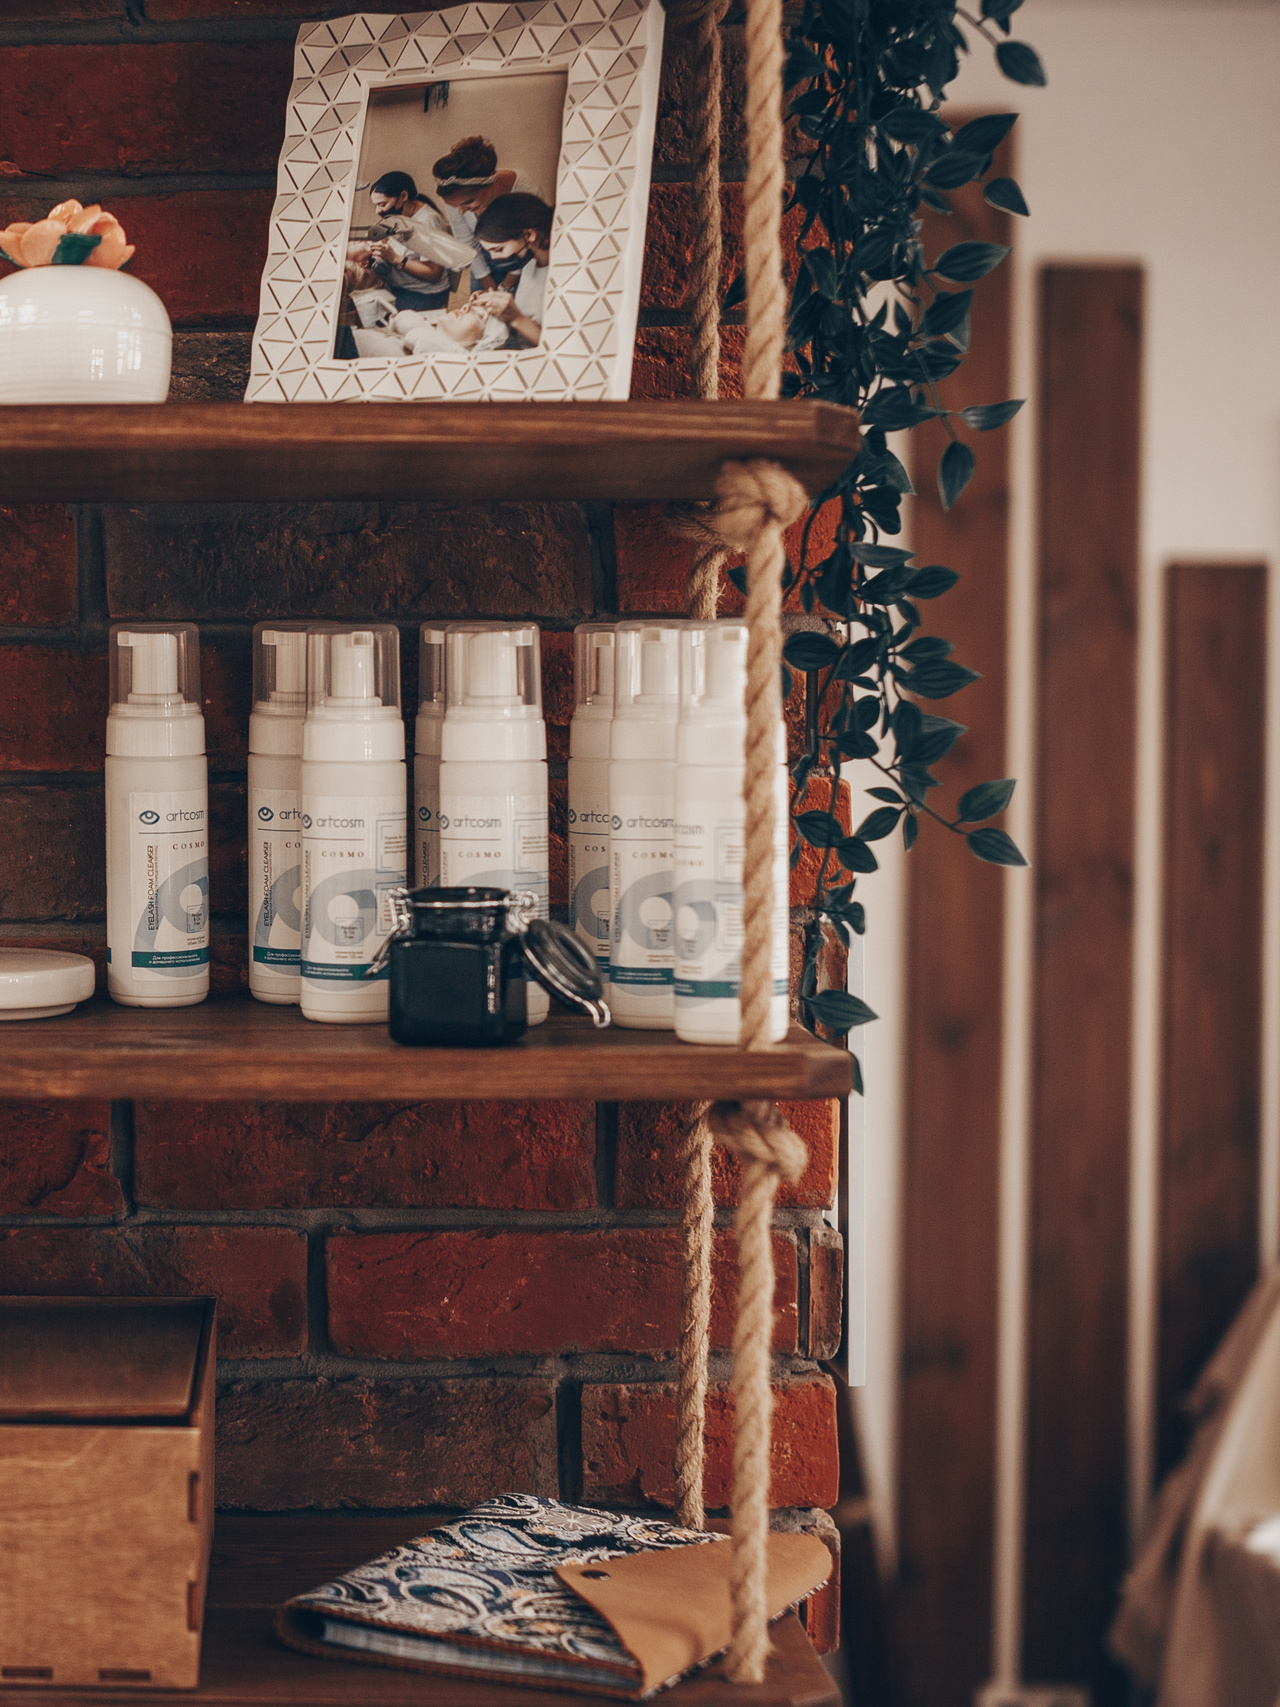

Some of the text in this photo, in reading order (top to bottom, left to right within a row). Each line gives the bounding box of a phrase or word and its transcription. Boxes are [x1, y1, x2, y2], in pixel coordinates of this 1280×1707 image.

[166, 809, 205, 822] artcosm
[316, 815, 365, 828] artcosm
[453, 815, 502, 828] artcosm
[172, 841, 205, 850] COSMO
[458, 851, 502, 859] COSMO
[147, 901, 155, 931] EYELASH
